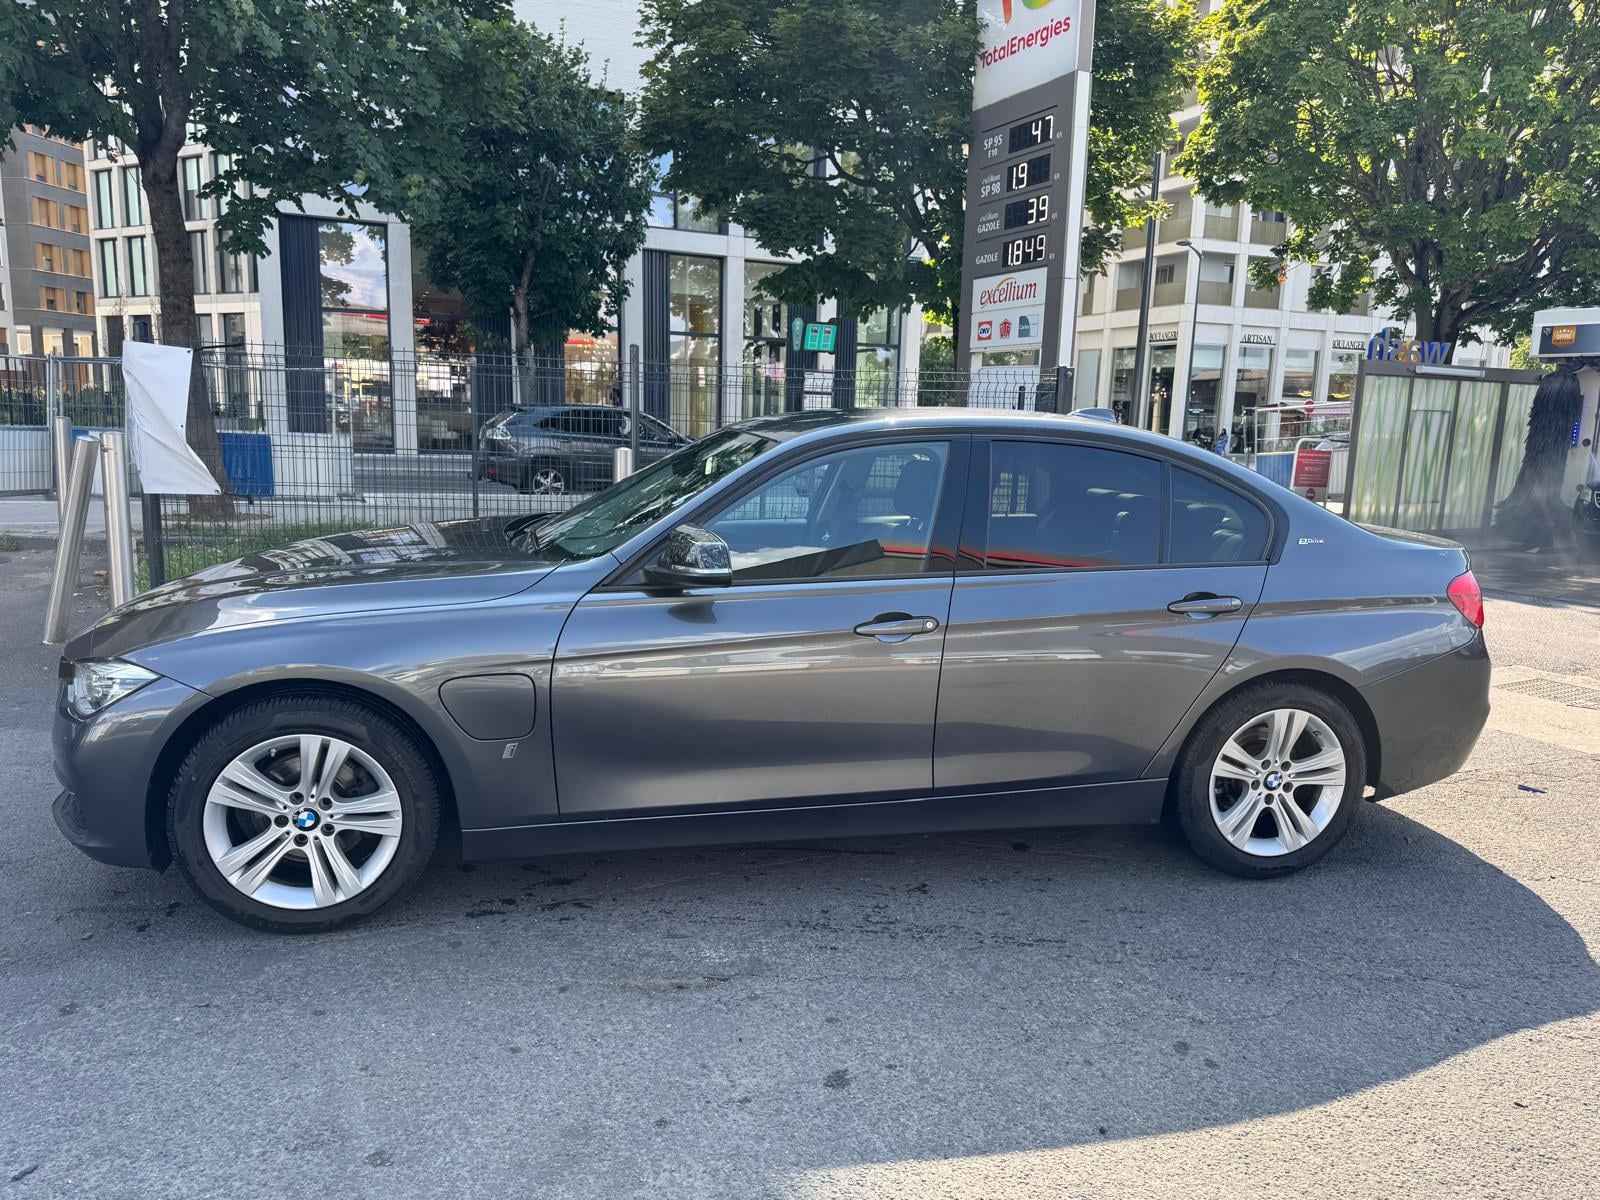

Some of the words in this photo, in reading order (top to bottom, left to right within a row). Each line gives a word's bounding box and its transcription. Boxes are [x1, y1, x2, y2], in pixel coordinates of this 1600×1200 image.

[980, 16, 1071, 69] TotalEnergies
[1032, 114, 1054, 143] 47
[983, 137, 993, 150] SP
[993, 134, 1003, 147] 95
[988, 148, 998, 158] E10
[981, 184, 991, 198] SP
[991, 183, 1001, 195] 98
[1027, 195, 1049, 225] 39
[977, 220, 1000, 233] GAZOLE
[975, 252, 999, 264] GAZOLE
[1007, 234, 1046, 266] 1.849
[980, 281, 1037, 308] excellium
[1242, 333, 1273, 344] ARTISAN
